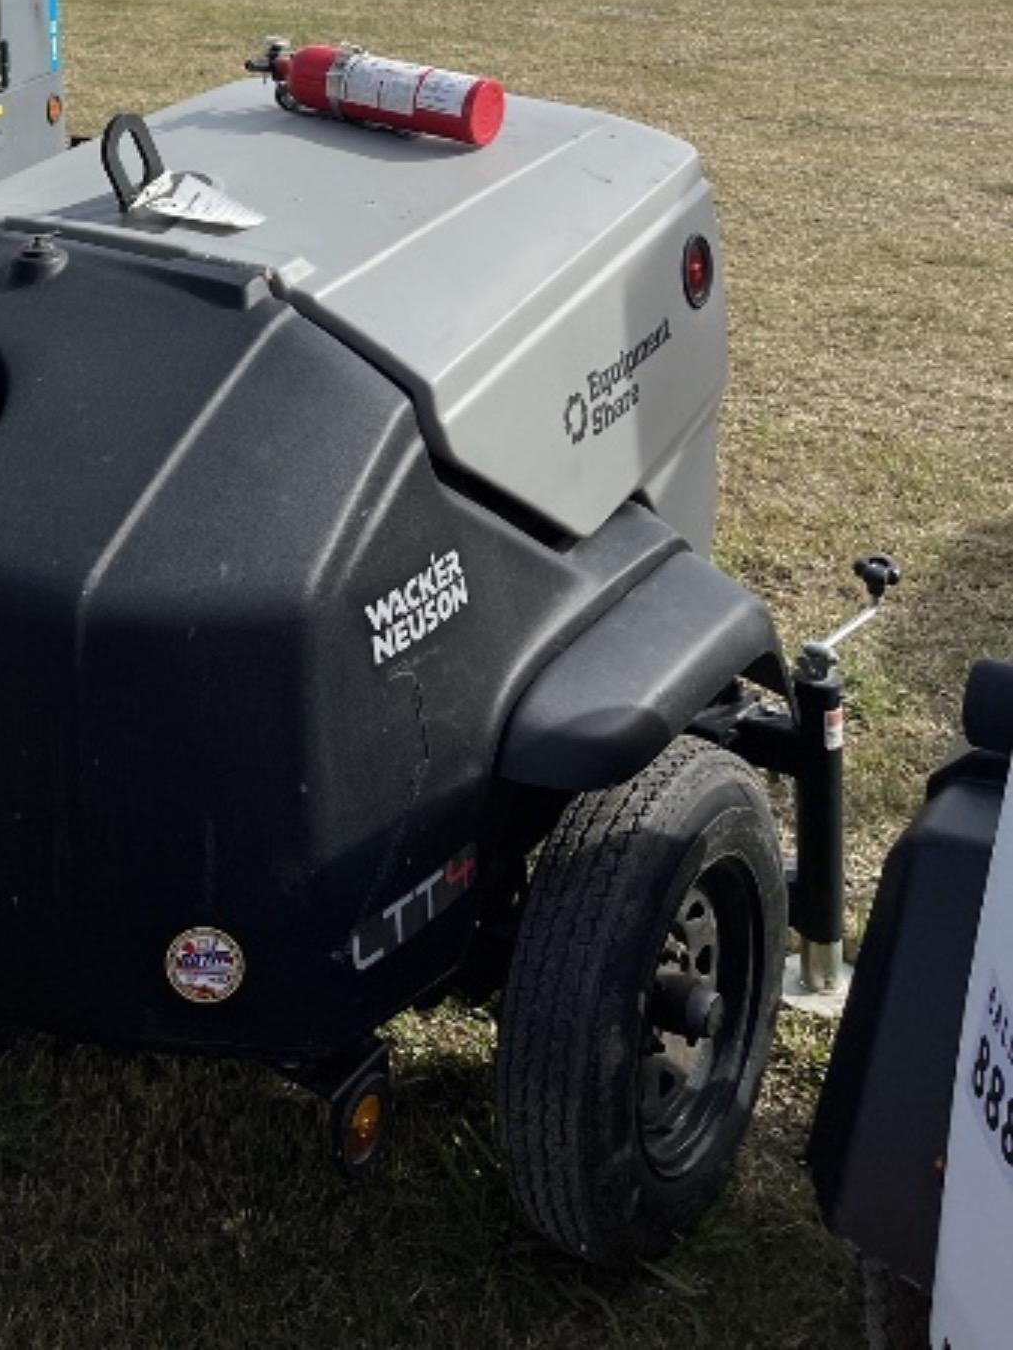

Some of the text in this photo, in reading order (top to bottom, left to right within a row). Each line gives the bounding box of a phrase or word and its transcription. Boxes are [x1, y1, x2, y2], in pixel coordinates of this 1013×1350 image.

[587, 317, 671, 402] Equipment
[592, 383, 639, 436] Share
[372, 575, 468, 665] NEUSON
[351, 857, 476, 971] LTT4
